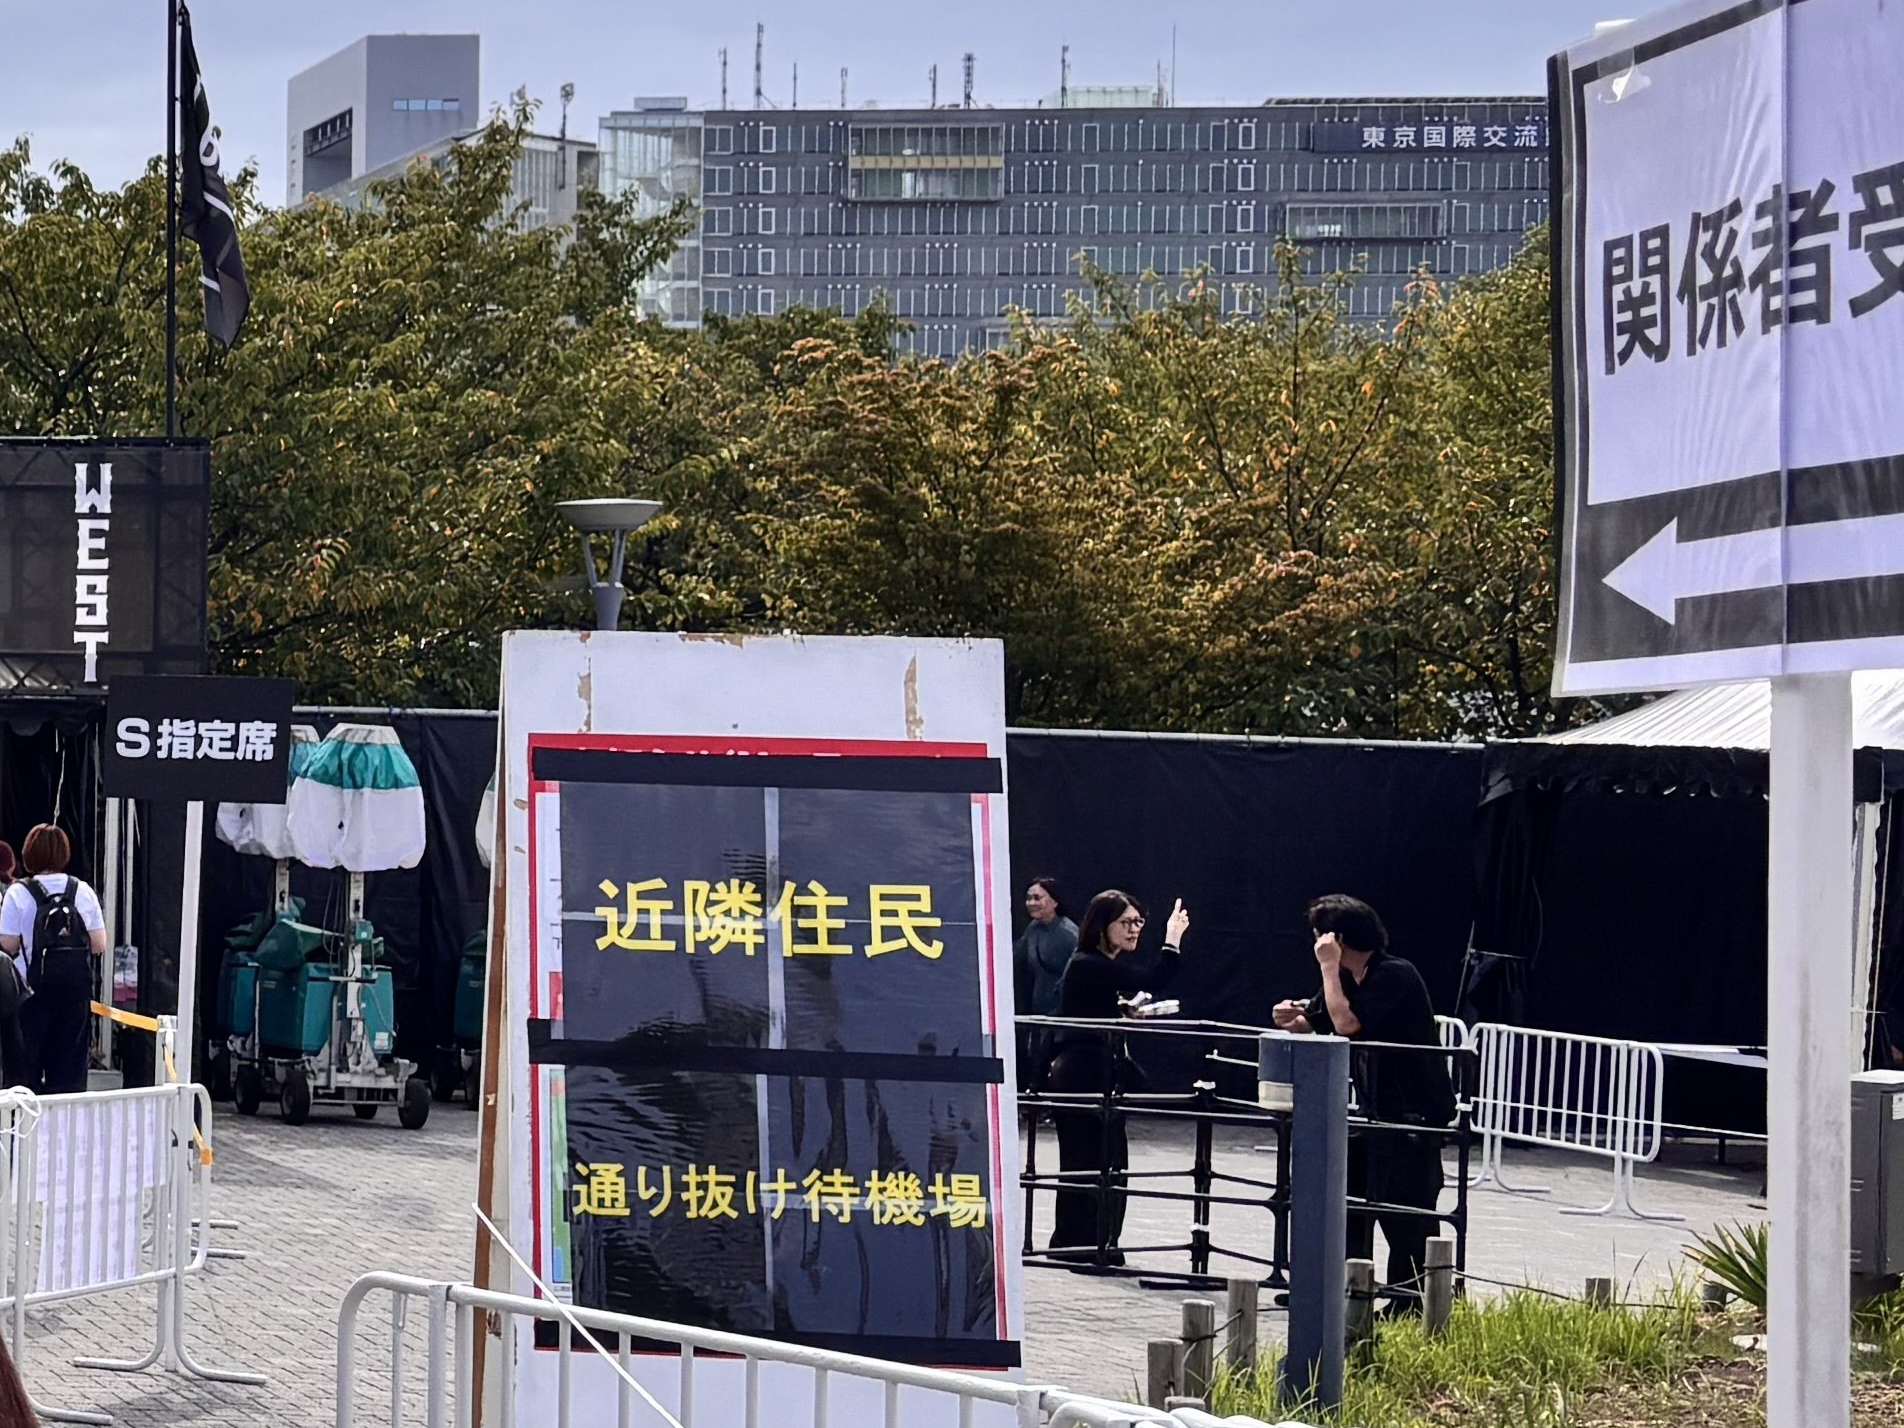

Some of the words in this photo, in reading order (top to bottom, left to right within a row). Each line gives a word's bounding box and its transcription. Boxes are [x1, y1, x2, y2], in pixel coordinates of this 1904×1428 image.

[1361, 125, 1549, 149] 東京国際交流
[1603, 160, 1904, 376] 関係者受
[73, 462, 114, 684] WEST
[115, 716, 277, 762] S指定席
[594, 877, 945, 960] 近隣住民
[571, 1160, 989, 1230] 通り抜け待機場
